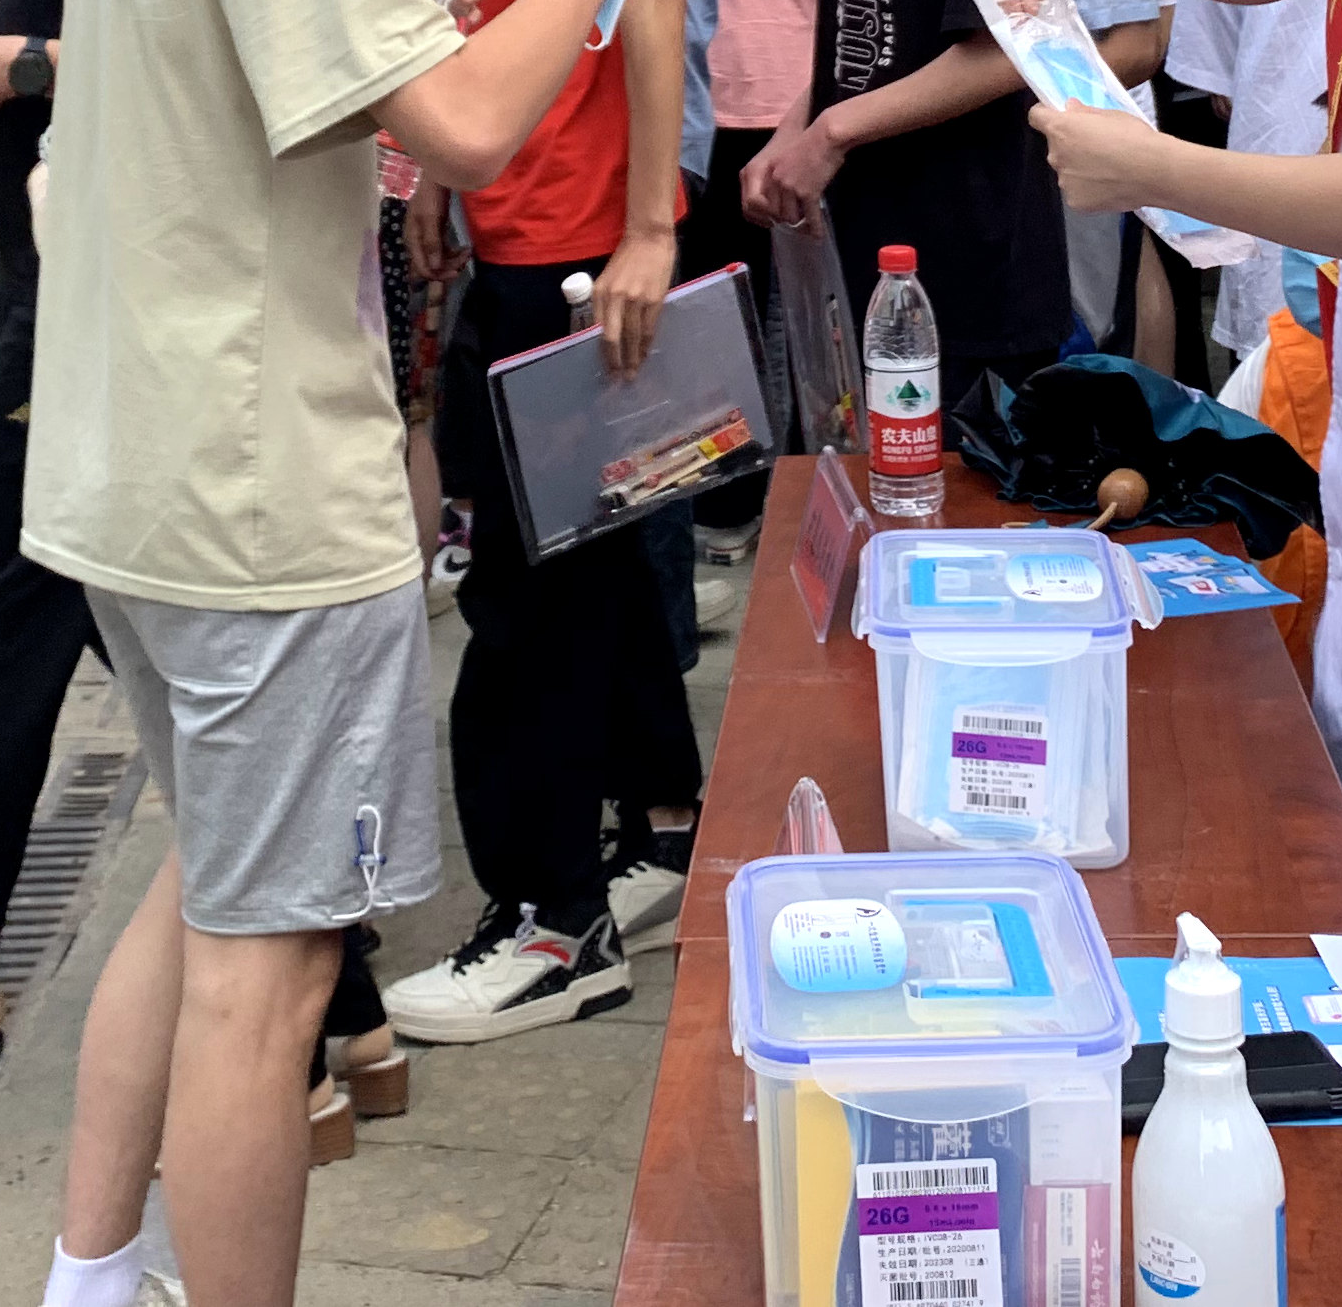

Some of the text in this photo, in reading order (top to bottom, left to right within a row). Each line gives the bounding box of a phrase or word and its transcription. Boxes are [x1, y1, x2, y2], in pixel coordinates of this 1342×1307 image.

[877, 11, 895, 67] SPACE
[957, 739, 988, 754] 26G
[867, 1206, 910, 1226] 26G
